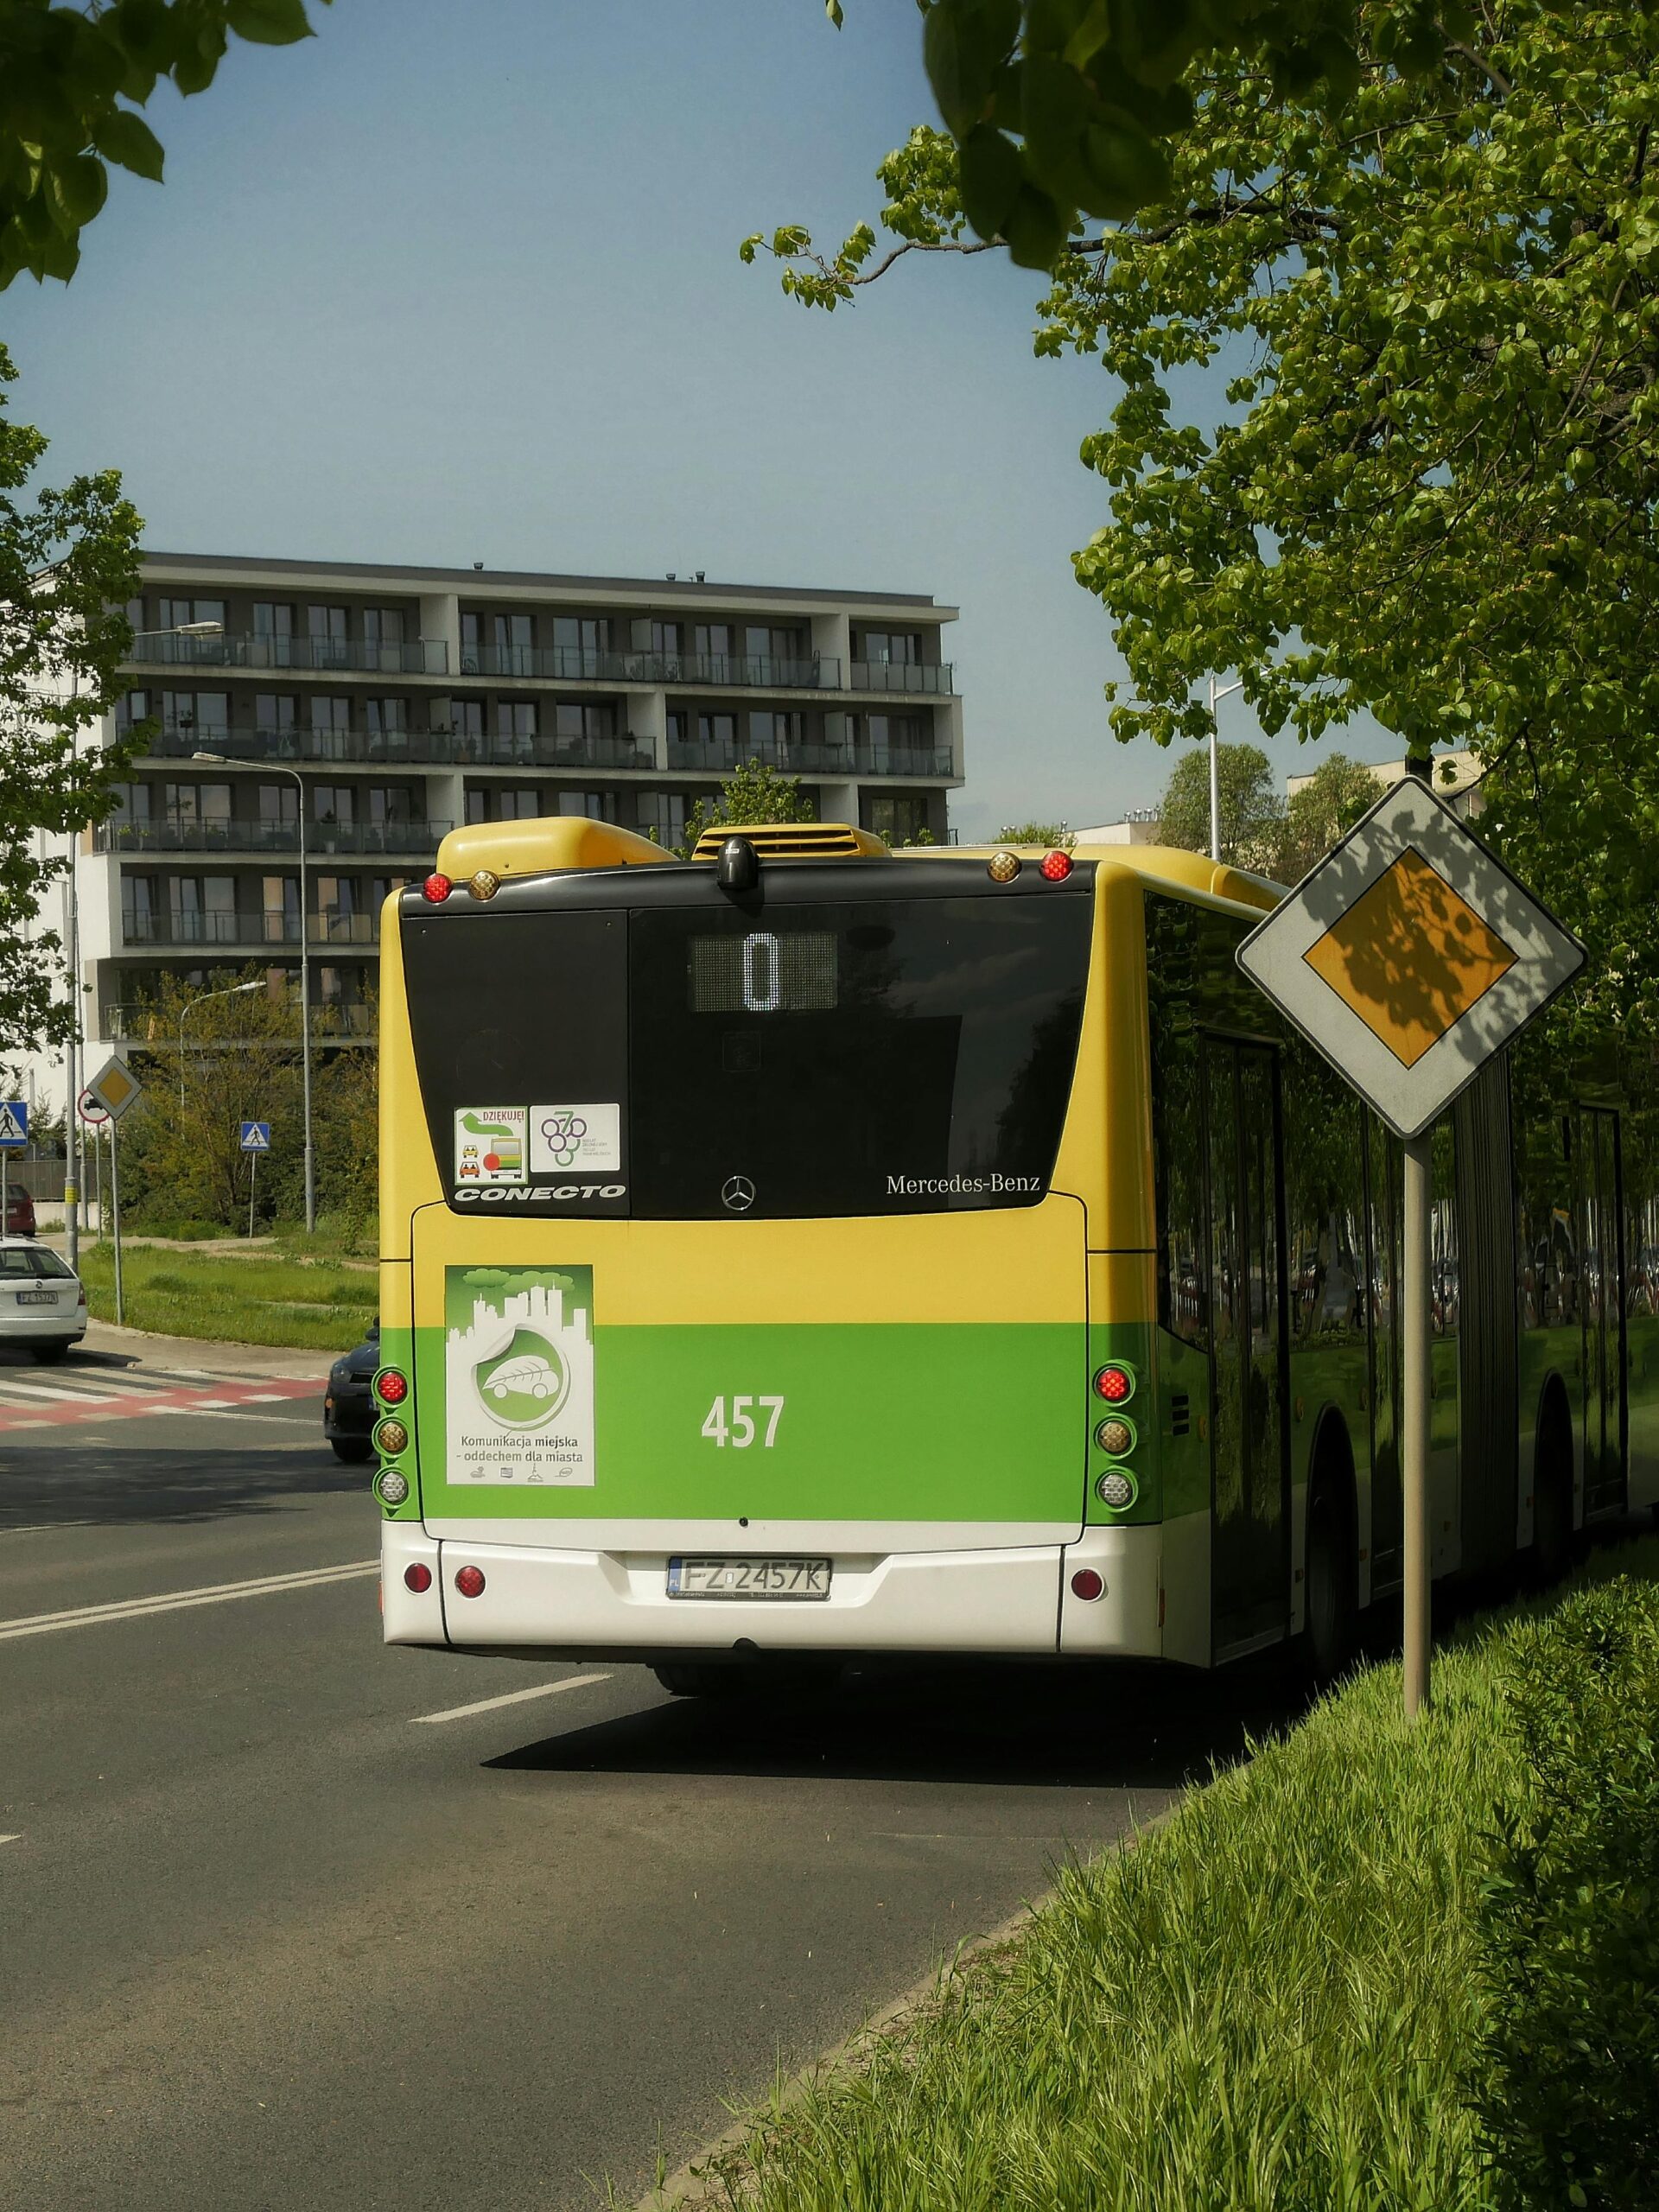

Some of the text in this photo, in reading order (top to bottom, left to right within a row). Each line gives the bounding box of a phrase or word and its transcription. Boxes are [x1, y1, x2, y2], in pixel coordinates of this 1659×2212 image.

[483, 1110, 524, 1123] DZIĘKUJĘ!
[886, 1173, 1040, 1194] Mercedes-Benz
[454, 1185, 626, 1202] CONECTO
[701, 1395, 785, 1447] 457
[461, 1436, 578, 1449] Komunikacja miejska
[464, 1451, 522, 1462] oddechem
[524, 1451, 543, 1462] dla
[545, 1451, 583, 1463] miasta
[670, 1579, 679, 1587] PL
[685, 1561, 823, 1590] FZ 2457K
